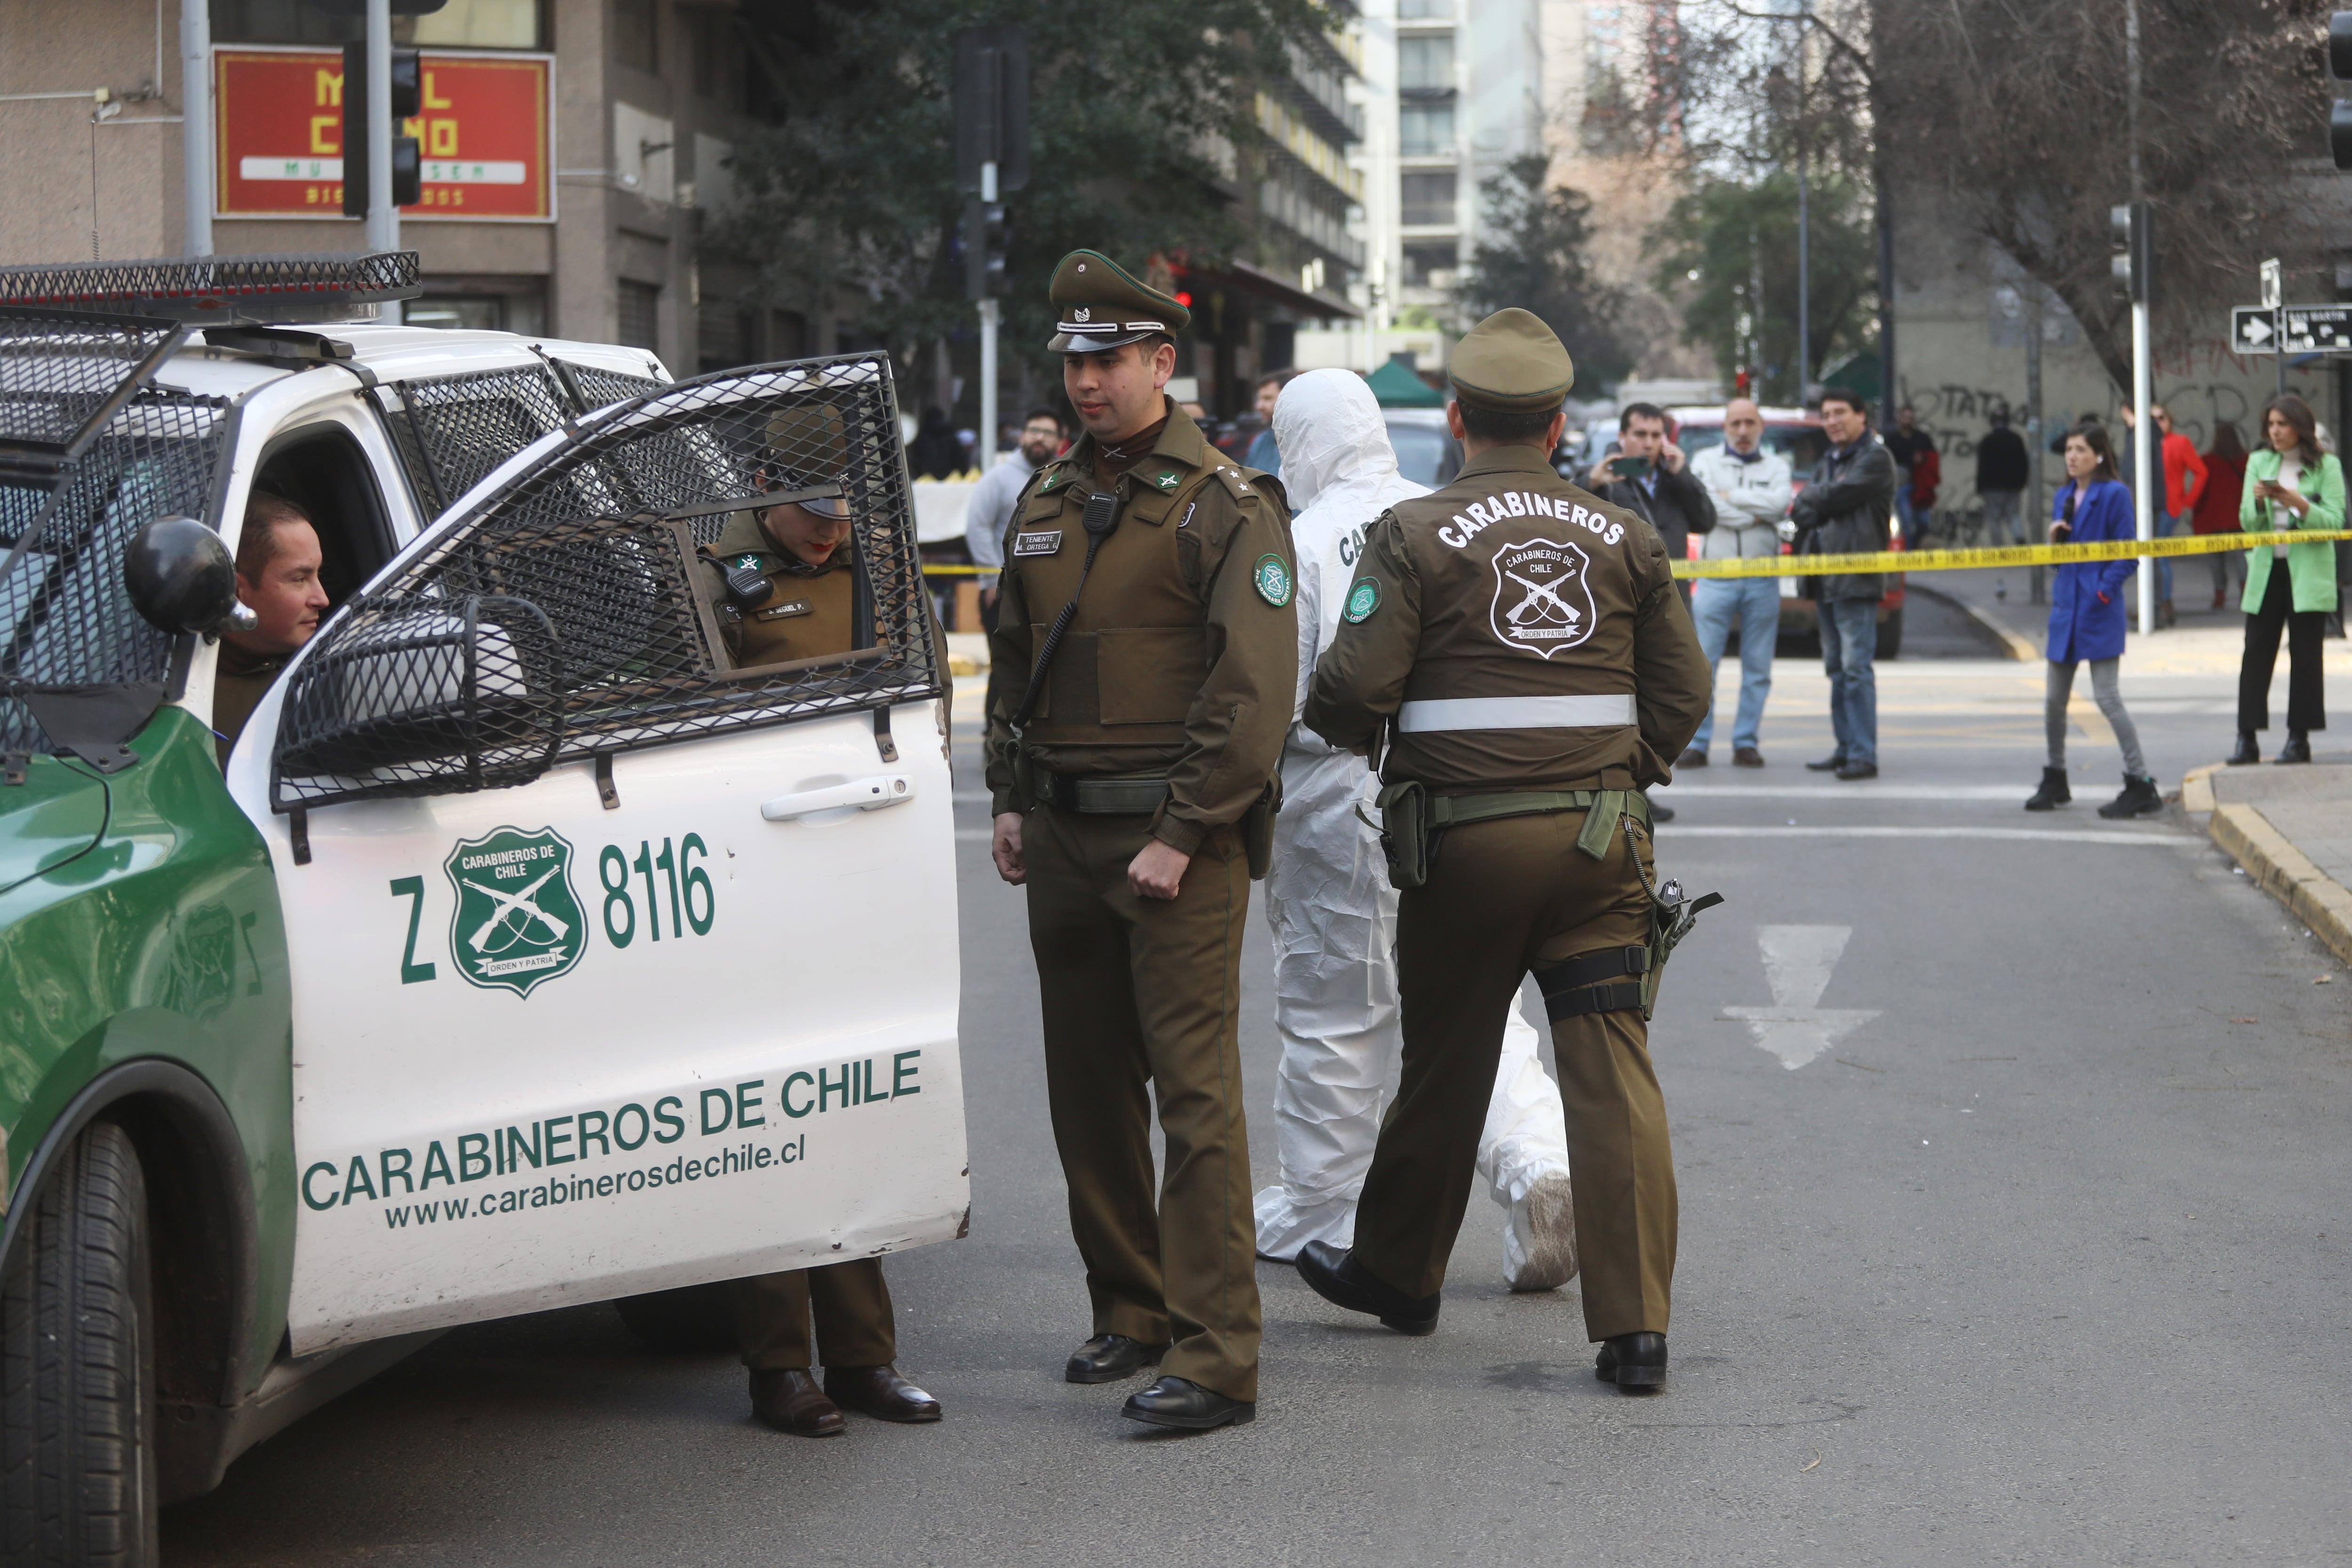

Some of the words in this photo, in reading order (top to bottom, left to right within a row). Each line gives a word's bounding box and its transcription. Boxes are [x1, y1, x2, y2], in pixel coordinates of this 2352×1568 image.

[1438, 491, 1624, 549] CARABINEROS
[1506, 549, 1561, 568] CARABINEROS
[1563, 555, 1574, 567] DE
[1530, 564, 1552, 573] CHILE
[776, 604, 796, 613] SEGUEL
[462, 848, 537, 870] CARABINEROS
[540, 845, 555, 858] DE
[495, 863, 527, 879] CHILE
[390, 875, 436, 984] Z
[599, 832, 715, 949] 8116
[491, 962, 517, 973] ORDEN
[526, 957, 553, 967] PATRIA
[302, 1096, 685, 1212] CARABINEROS
[700, 1079, 766, 1136] DE
[781, 1049, 921, 1118] CHILE
[385, 1134, 805, 1229] www.carabinerosdechile.cl
